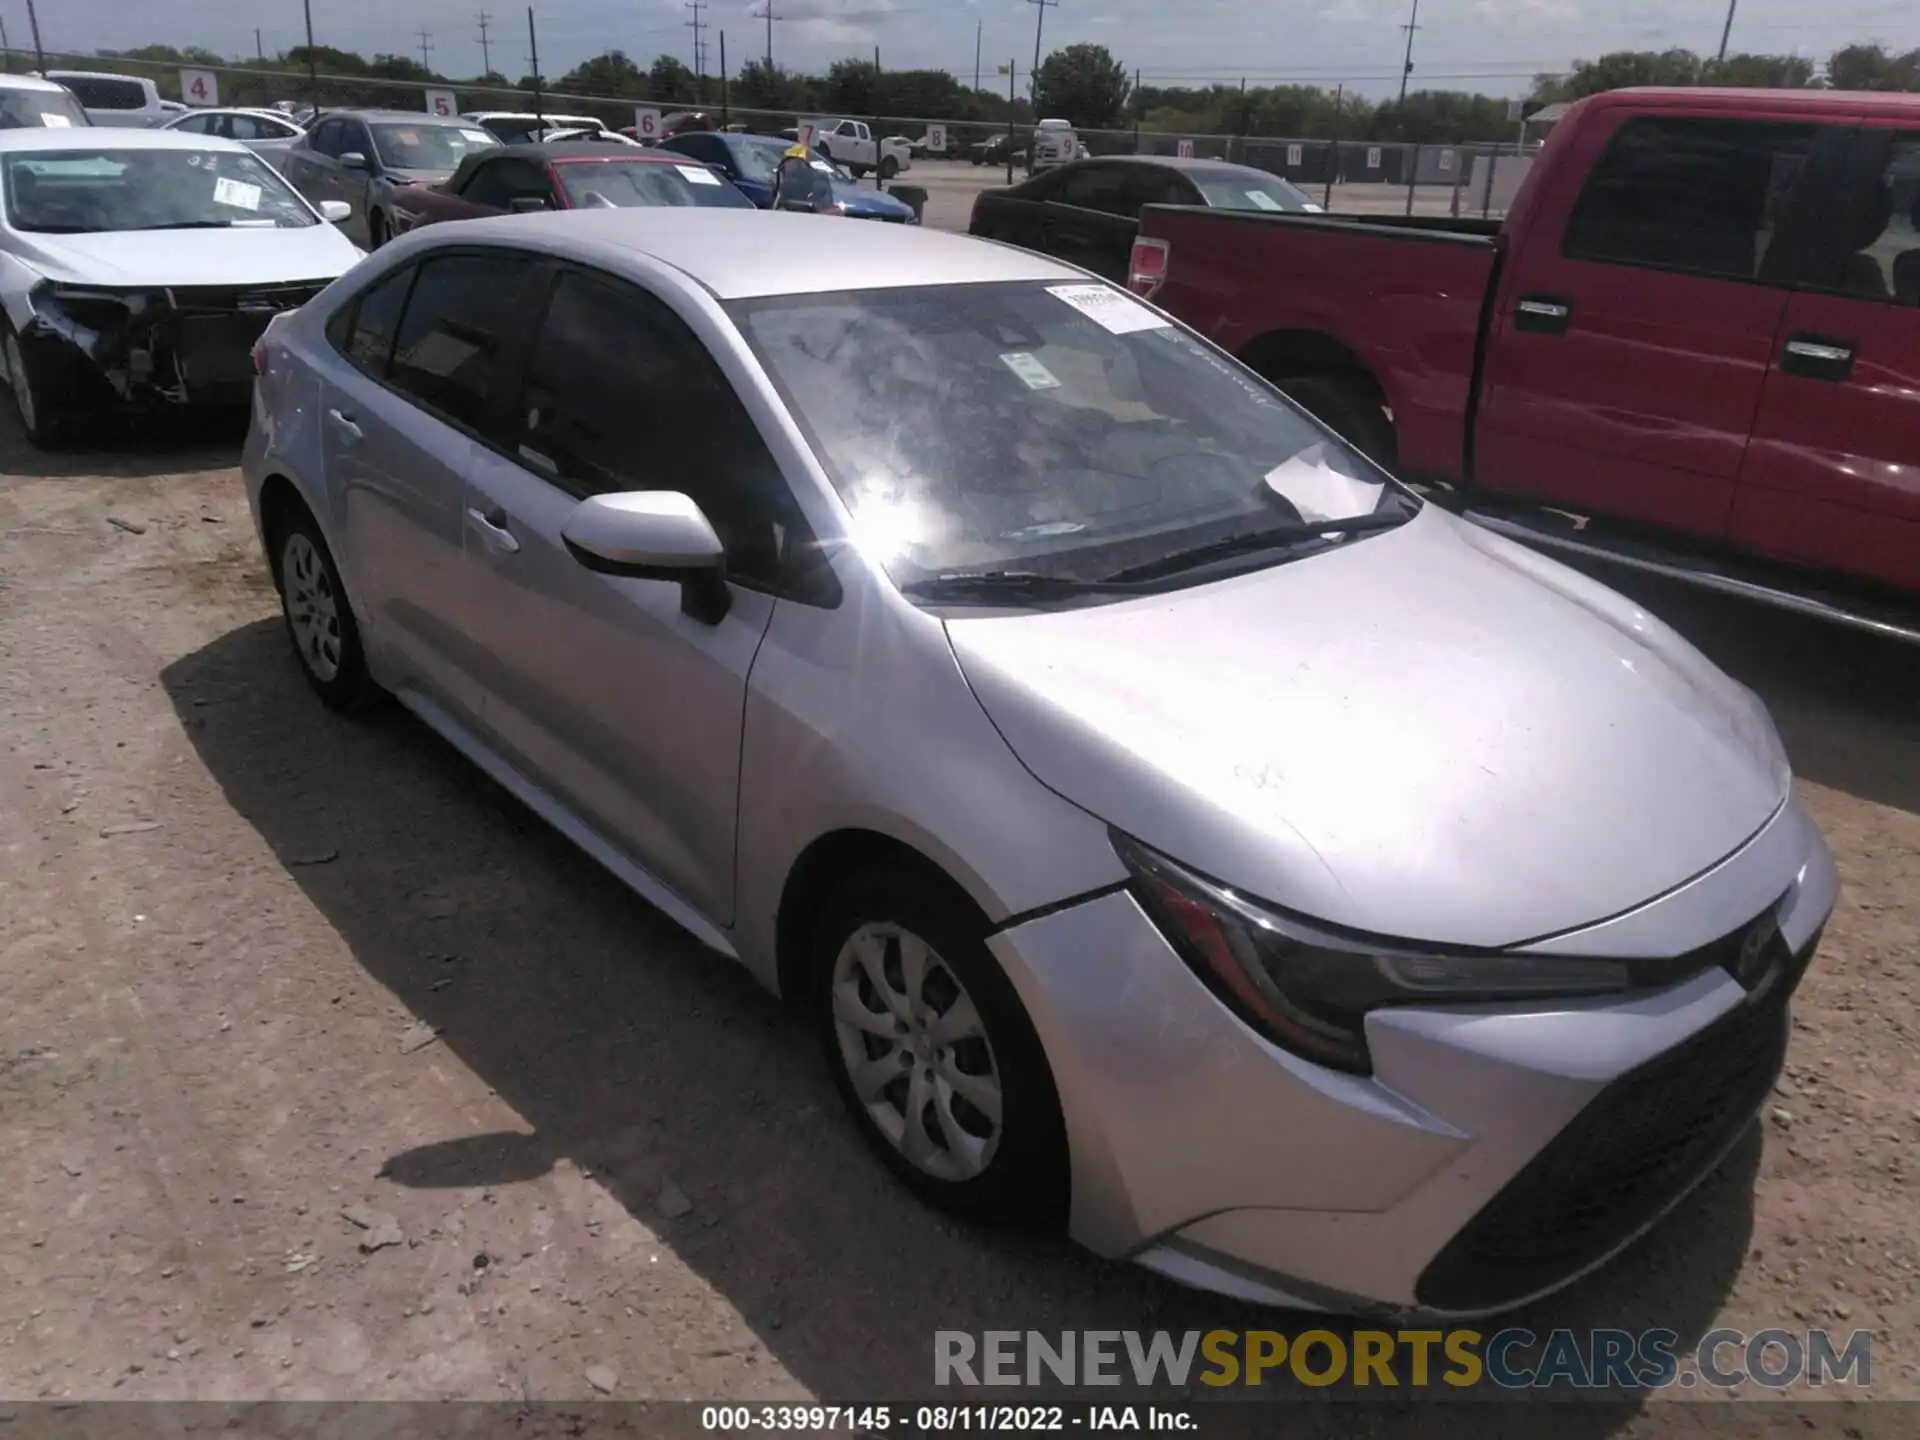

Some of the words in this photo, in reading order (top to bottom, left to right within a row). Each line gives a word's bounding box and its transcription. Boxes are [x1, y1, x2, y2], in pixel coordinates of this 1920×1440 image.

[190, 77, 208, 100] 4
[434, 97, 450, 117] 5
[641, 114, 654, 133] 6
[803, 124, 814, 145] 7
[932, 130, 941, 147] 8
[1063, 138, 1072, 154] 9
